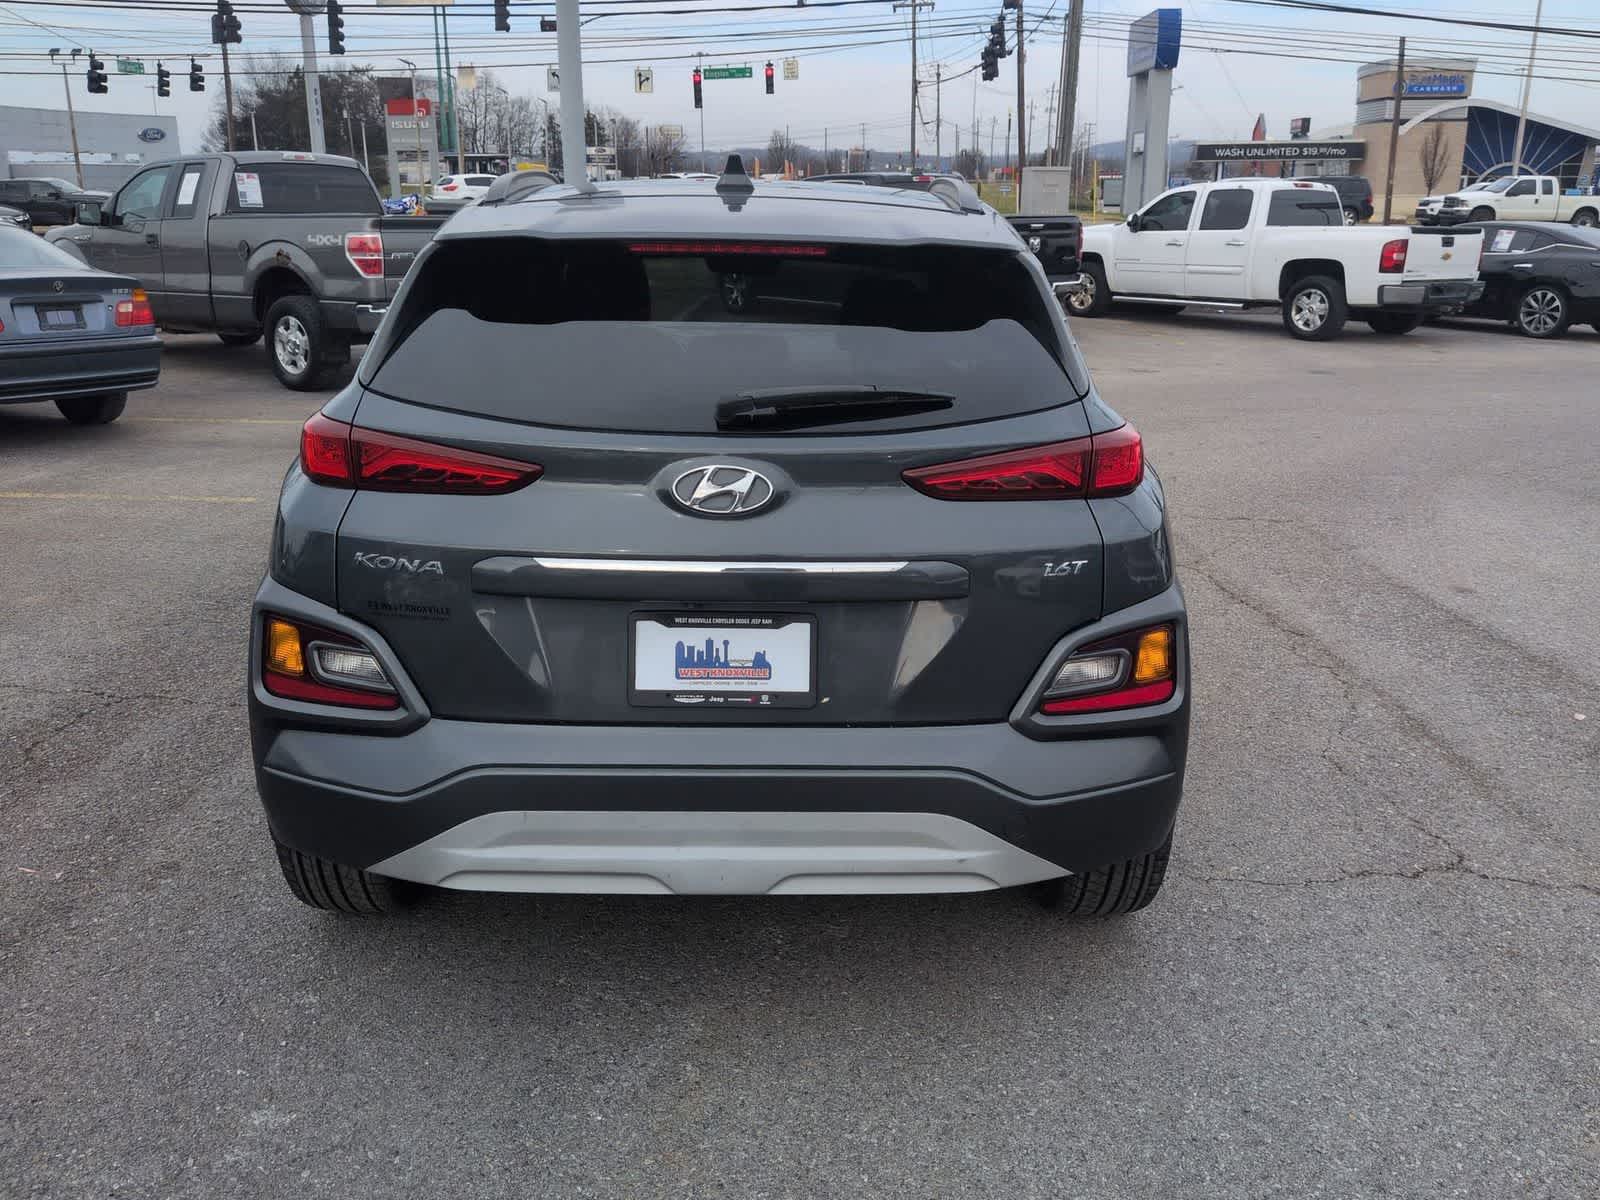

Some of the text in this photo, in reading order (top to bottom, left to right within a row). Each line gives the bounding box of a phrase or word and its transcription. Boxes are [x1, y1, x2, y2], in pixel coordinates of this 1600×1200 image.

[1215, 149, 1245, 157] WASH
[1246, 147, 1300, 156] UNLIMITED
[354, 552, 443, 575] KONA
[679, 668, 769, 677] WEST KNOXVILLE
